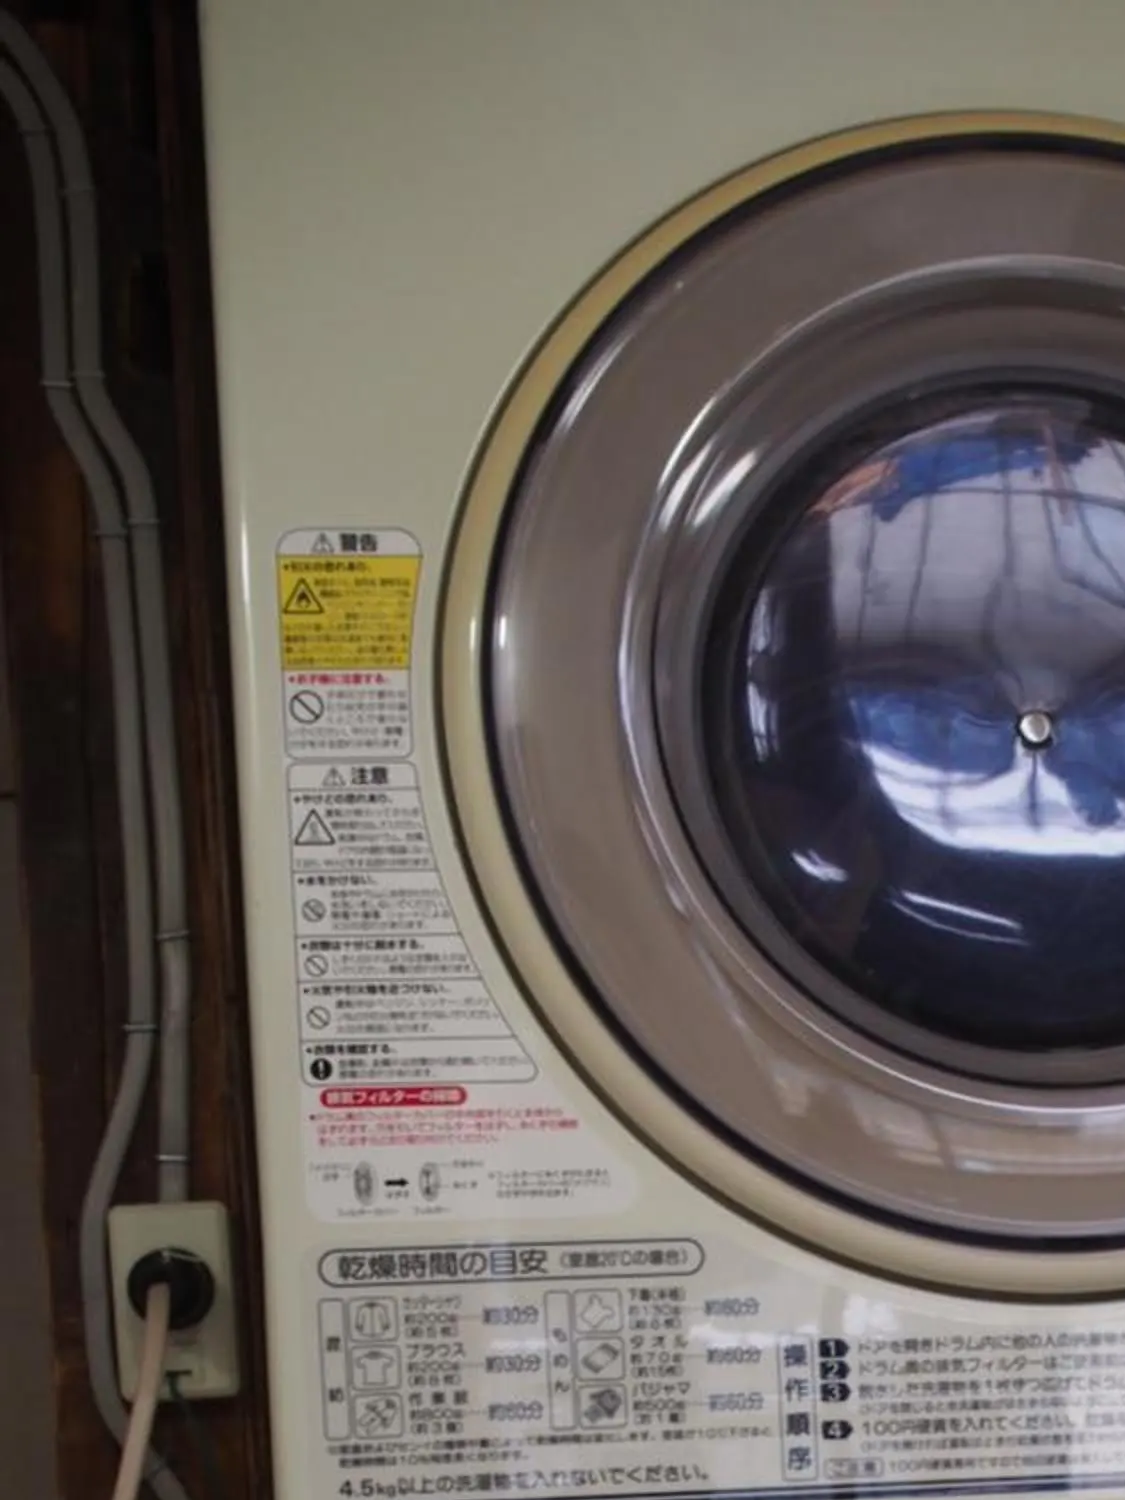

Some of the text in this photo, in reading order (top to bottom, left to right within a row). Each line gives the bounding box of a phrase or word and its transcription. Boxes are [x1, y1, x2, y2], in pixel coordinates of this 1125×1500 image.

[350, 766, 389, 786] 注意
[338, 1248, 548, 1280] 乾燥時間の目安
